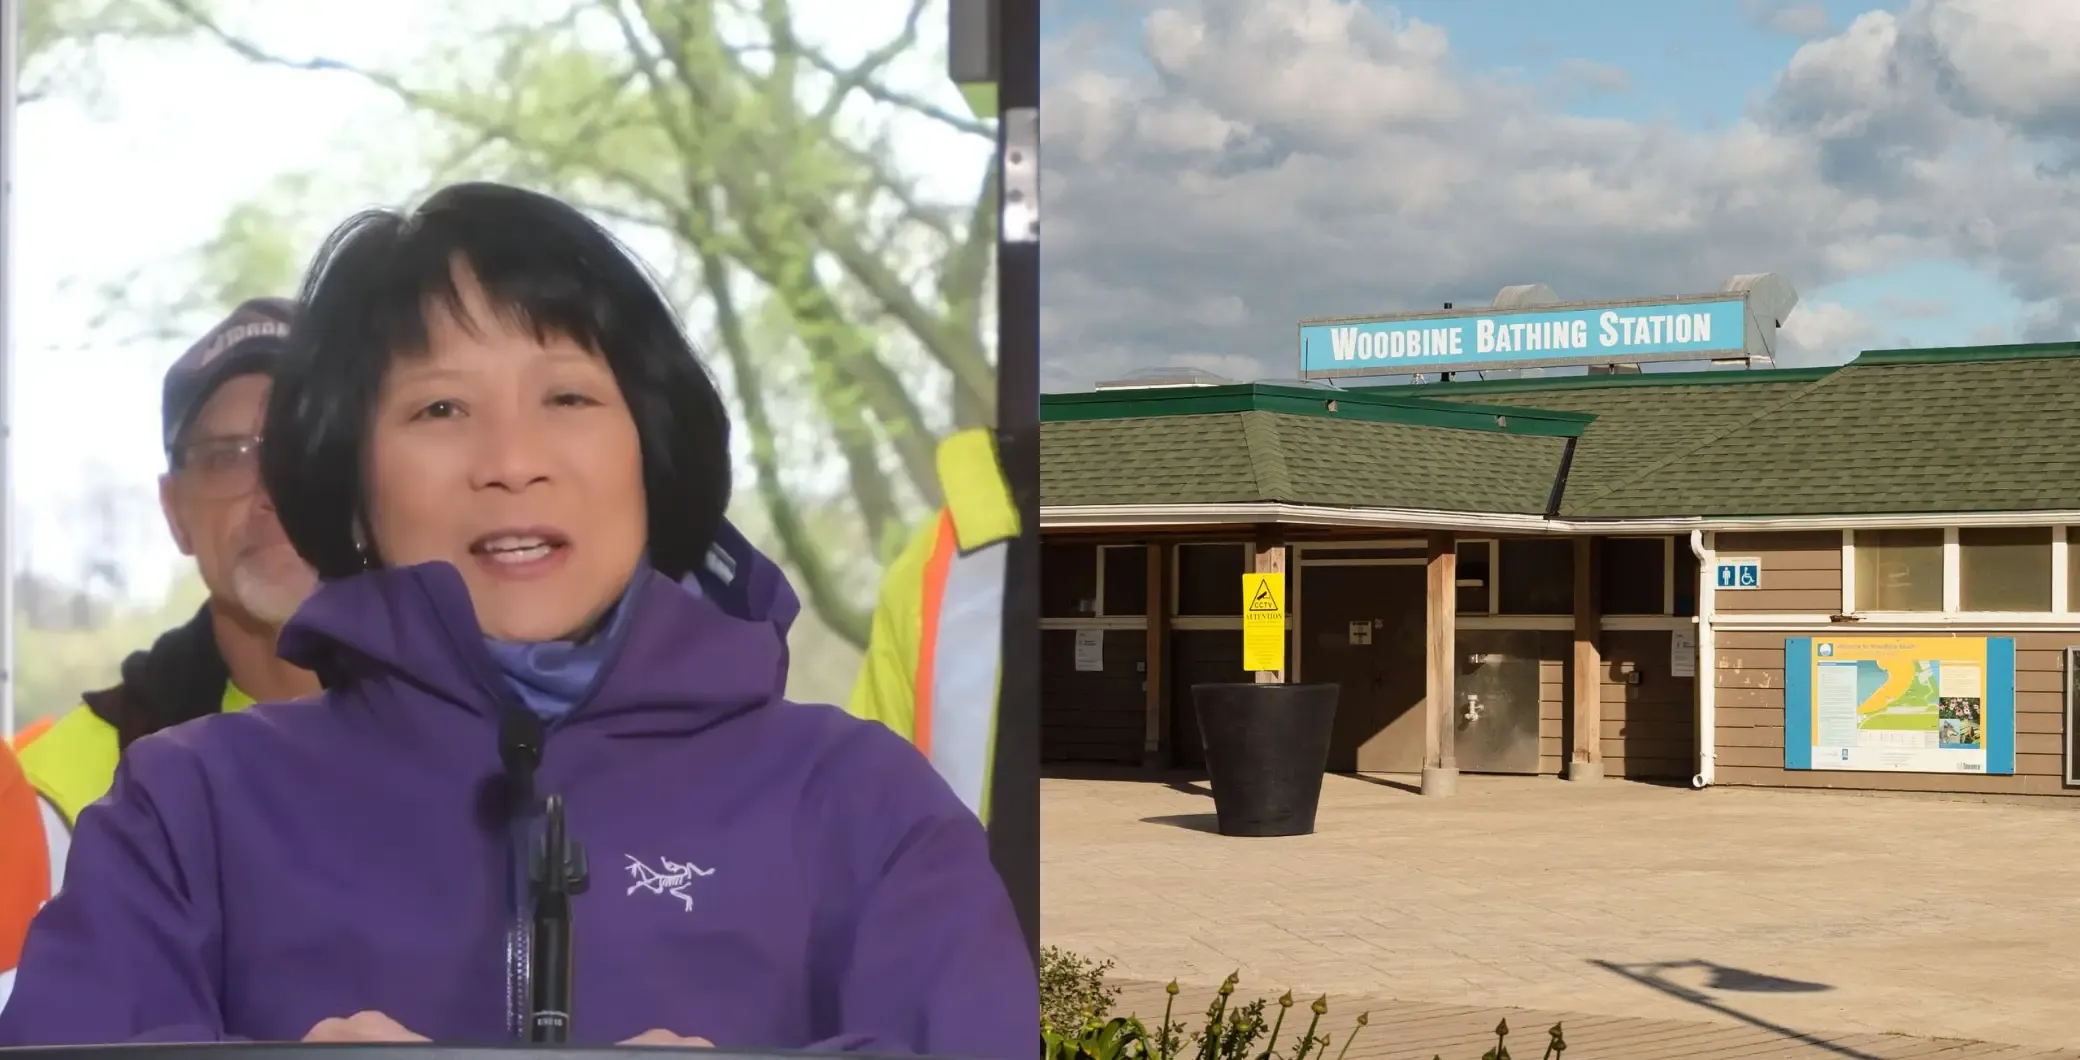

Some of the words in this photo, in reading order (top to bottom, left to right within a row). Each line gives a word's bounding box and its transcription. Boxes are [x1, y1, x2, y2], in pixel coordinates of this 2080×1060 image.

[1331, 327, 1462, 360] WOODBINE
[1477, 319, 1587, 352] BATHING
[1600, 311, 1711, 347] STATION
